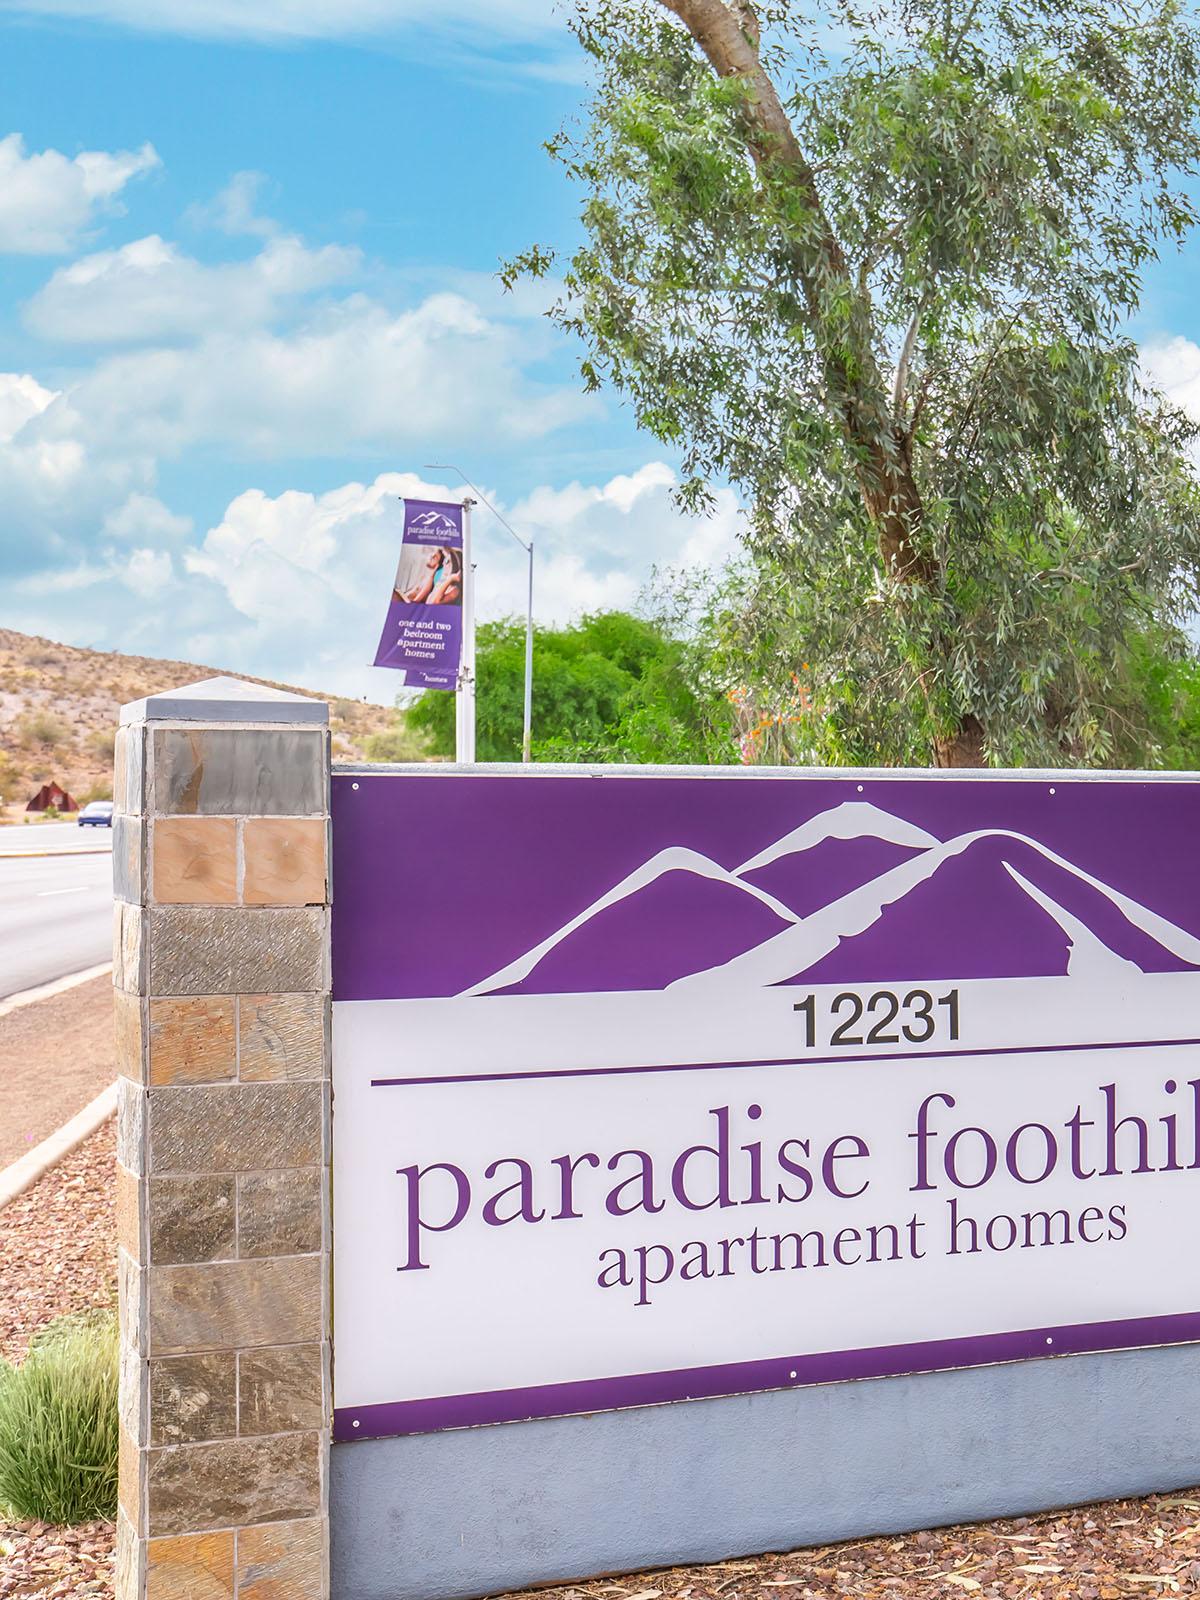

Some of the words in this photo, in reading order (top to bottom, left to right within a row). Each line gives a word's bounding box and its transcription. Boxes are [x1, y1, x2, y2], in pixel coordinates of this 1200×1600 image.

[398, 620, 415, 628] one
[416, 620, 434, 630] and
[436, 622, 452, 631] two
[403, 628, 443, 640] bedroom
[397, 638, 445, 650] apartment
[405, 648, 436, 659] homes
[793, 989, 959, 1048] 12231
[395, 1103, 871, 1272] paradise
[597, 1213, 927, 1307] apartment
[945, 1197, 1128, 1255] homes
